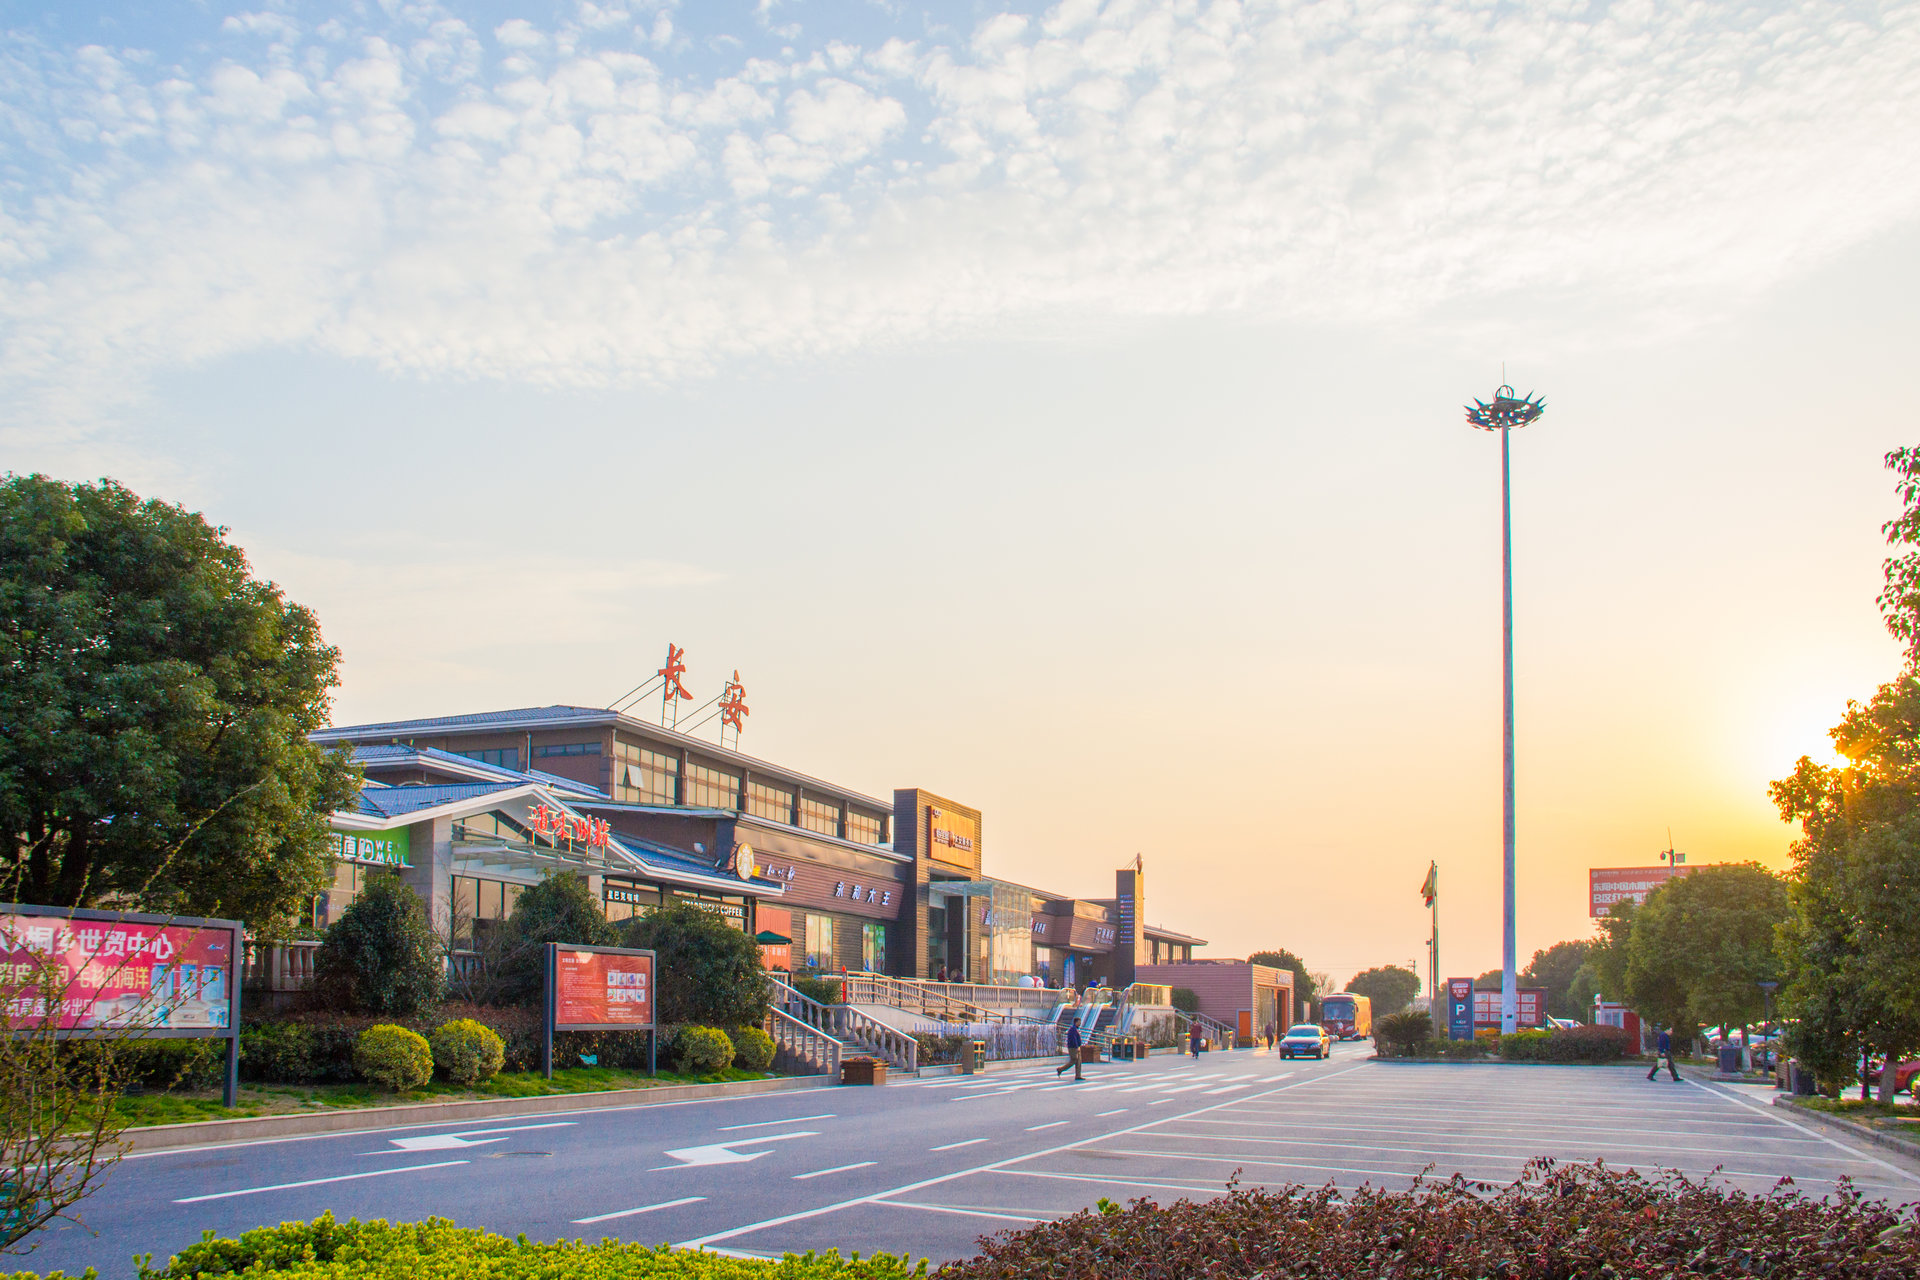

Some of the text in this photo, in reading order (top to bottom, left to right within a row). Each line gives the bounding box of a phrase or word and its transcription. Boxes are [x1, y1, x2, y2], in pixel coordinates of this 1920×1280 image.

[658, 643, 750, 734] 长安
[375, 840, 393, 852] WE
[376, 852, 407, 867] MALL
[607, 889, 640, 903] 星巴克咖啡
[835, 881, 891, 906] 永和大王
[720, 905, 743, 917] COFFEE
[1455, 1003, 1466, 1016] P
